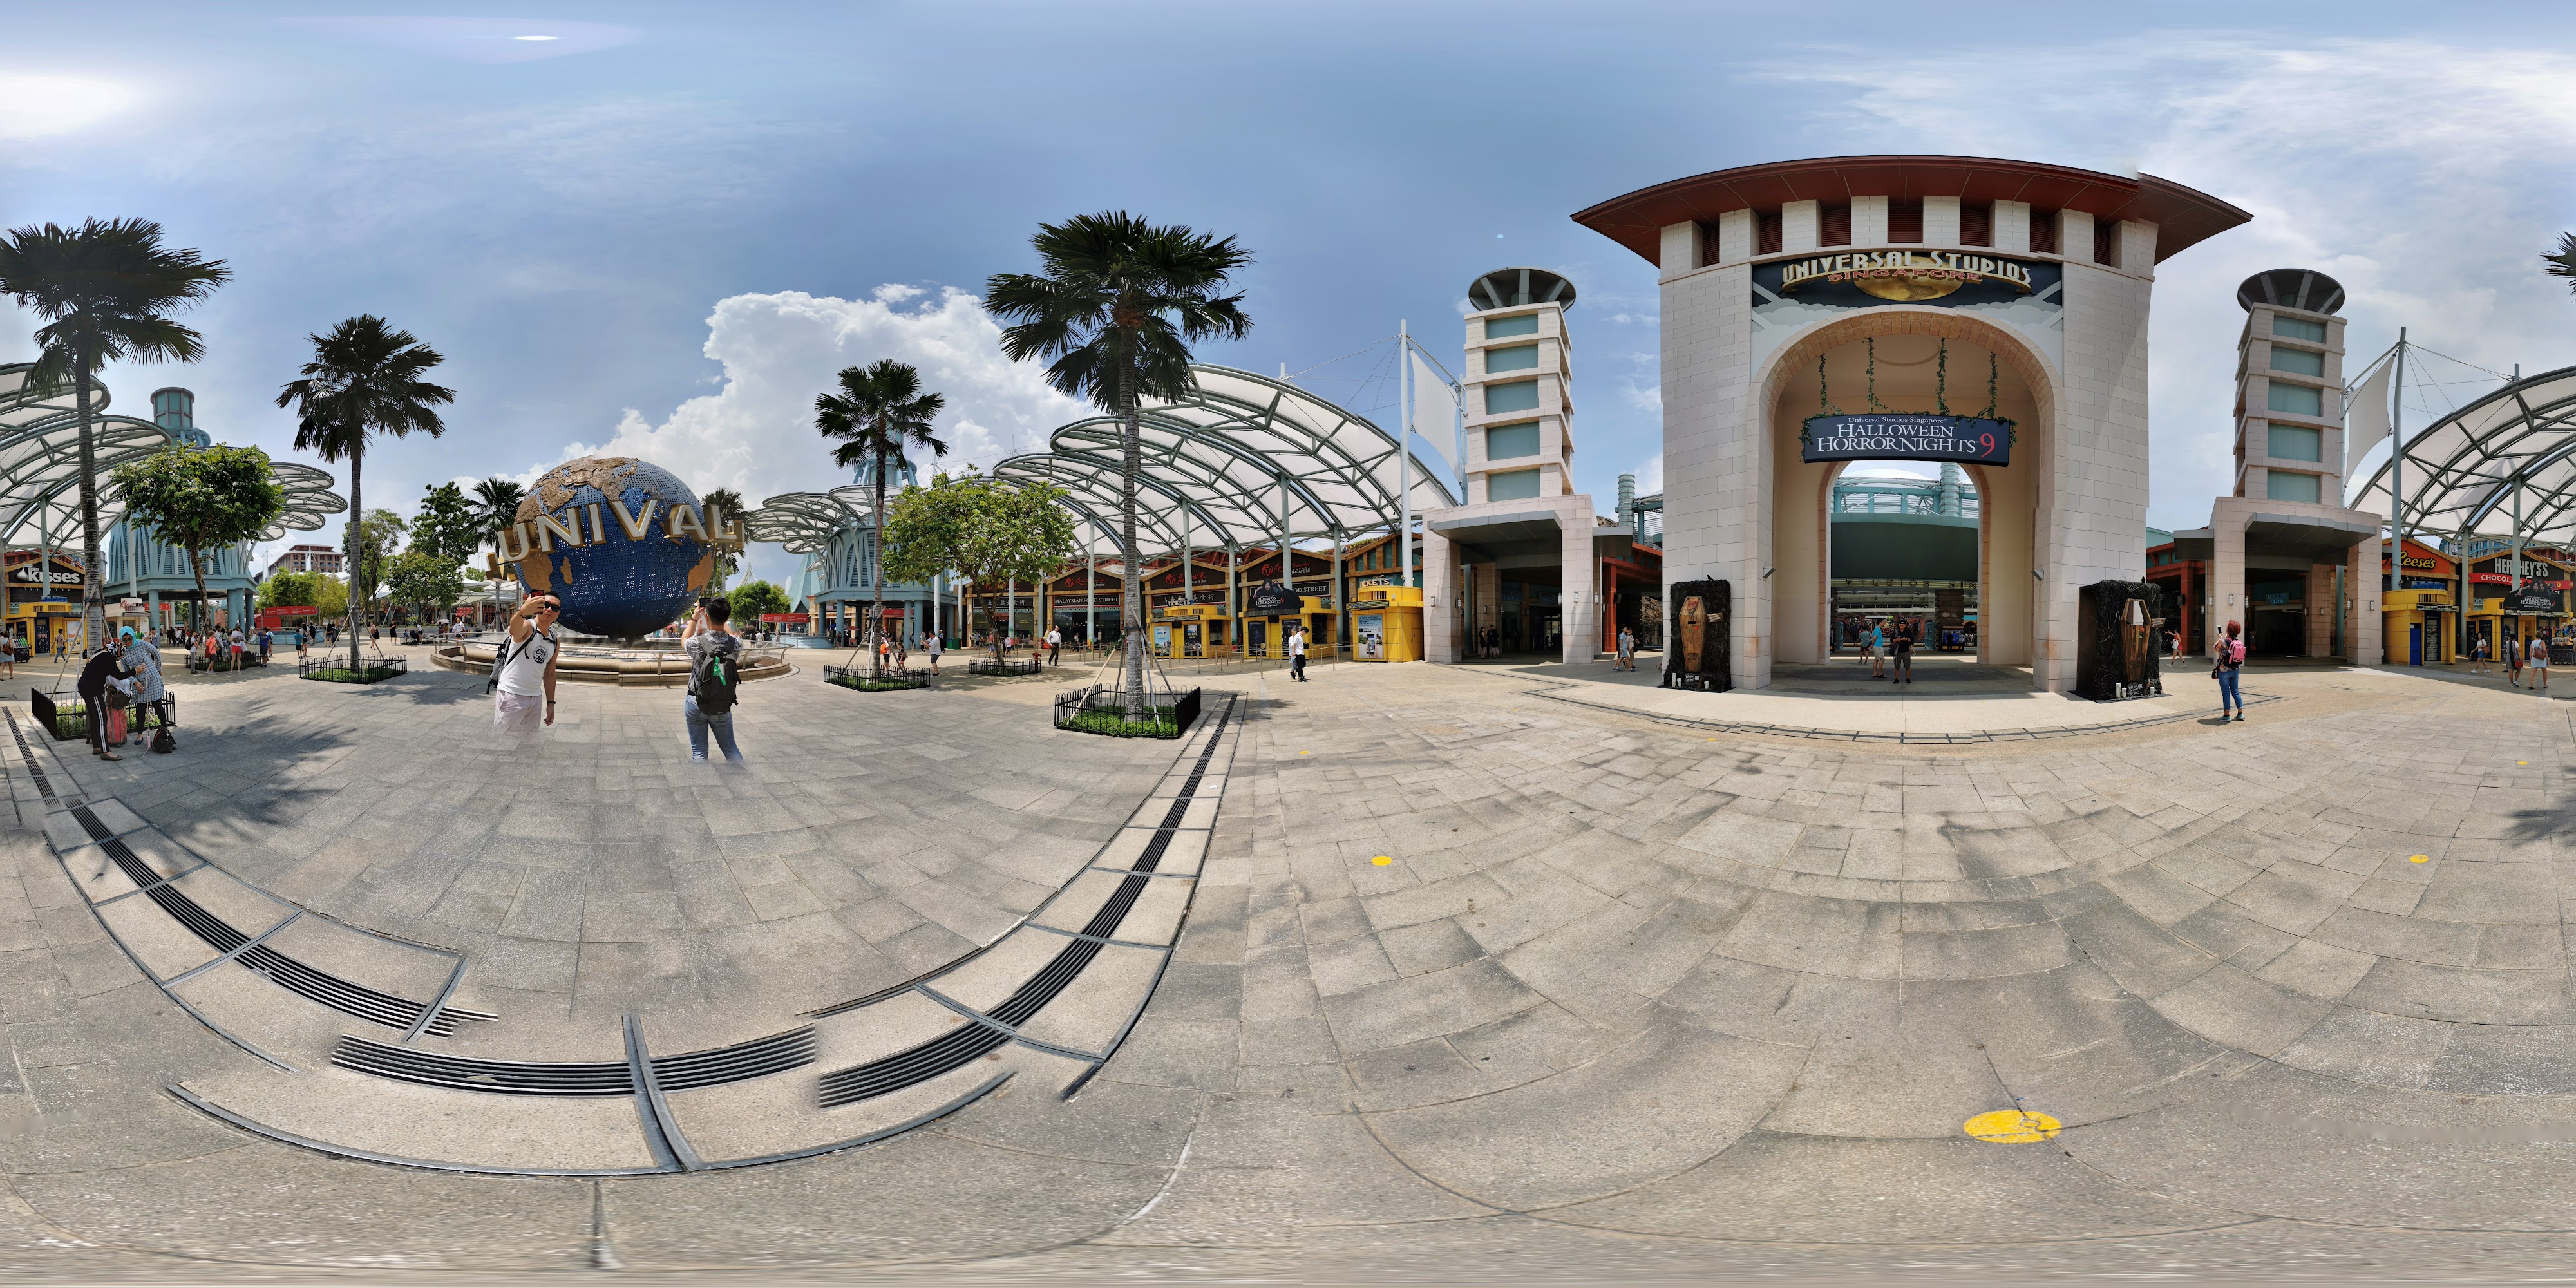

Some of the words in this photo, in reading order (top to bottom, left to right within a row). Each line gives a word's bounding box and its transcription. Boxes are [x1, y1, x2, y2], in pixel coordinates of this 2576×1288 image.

[1782, 251, 1913, 283] UNIVERSAL
[1931, 251, 2031, 284] STUDIOS
[1828, 268, 1983, 283] SINGAPORE
[1836, 424, 1954, 438] HALLOWEEN
[1816, 437, 1898, 452] HORROR
[1980, 433, 1995, 459] 9
[1360, 579, 1390, 587] TICKETS
